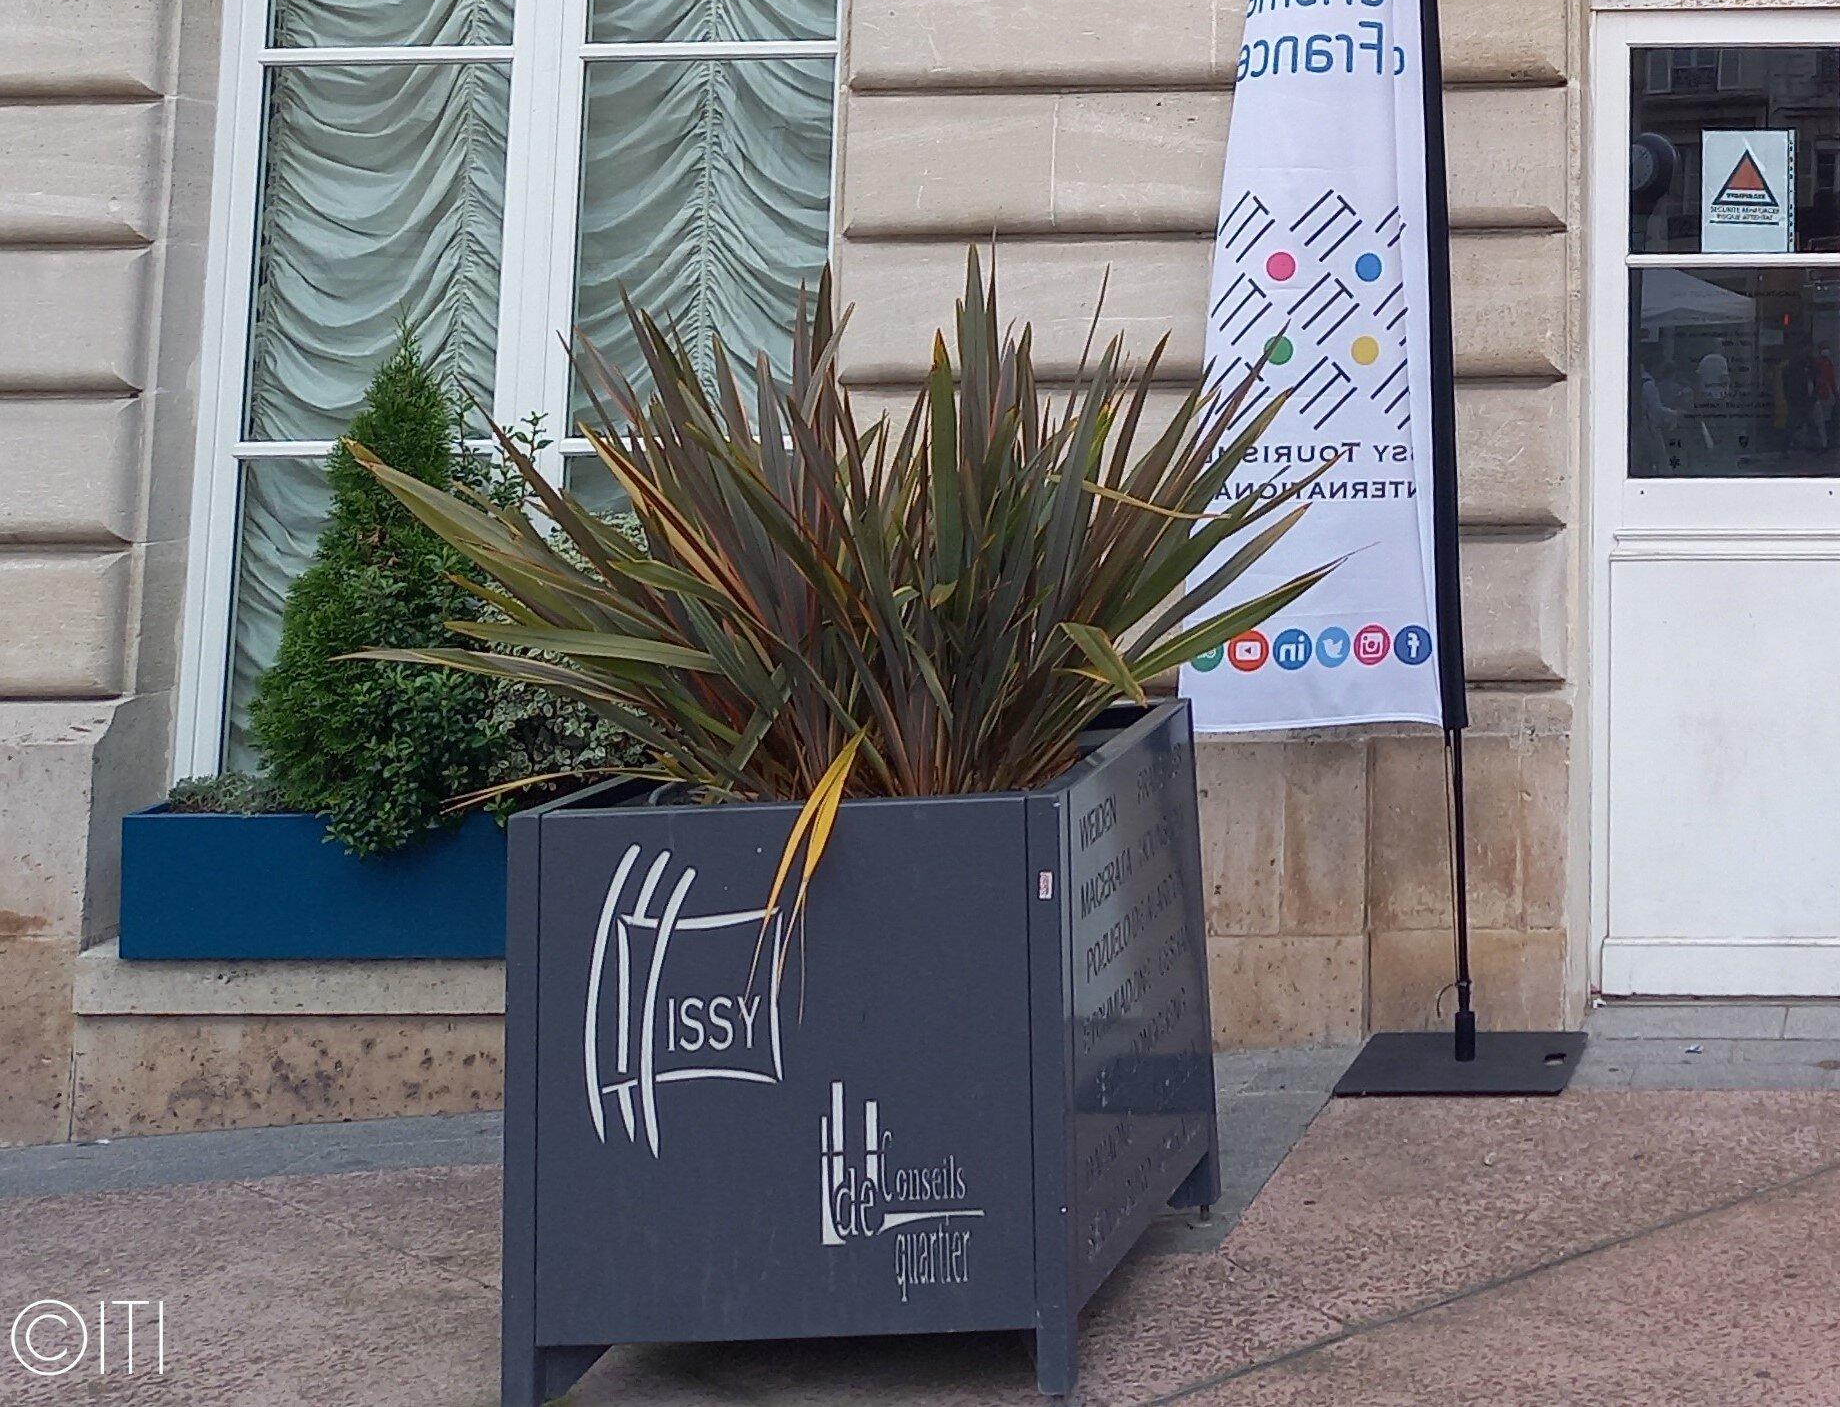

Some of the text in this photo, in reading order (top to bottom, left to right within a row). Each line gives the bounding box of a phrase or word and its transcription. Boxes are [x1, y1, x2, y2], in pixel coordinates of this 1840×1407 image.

[668, 995, 761, 1052] ISSY
[881, 1130, 966, 1201] Conseils
[836, 1168, 874, 1237] de
[896, 1215, 970, 1302] quartier
